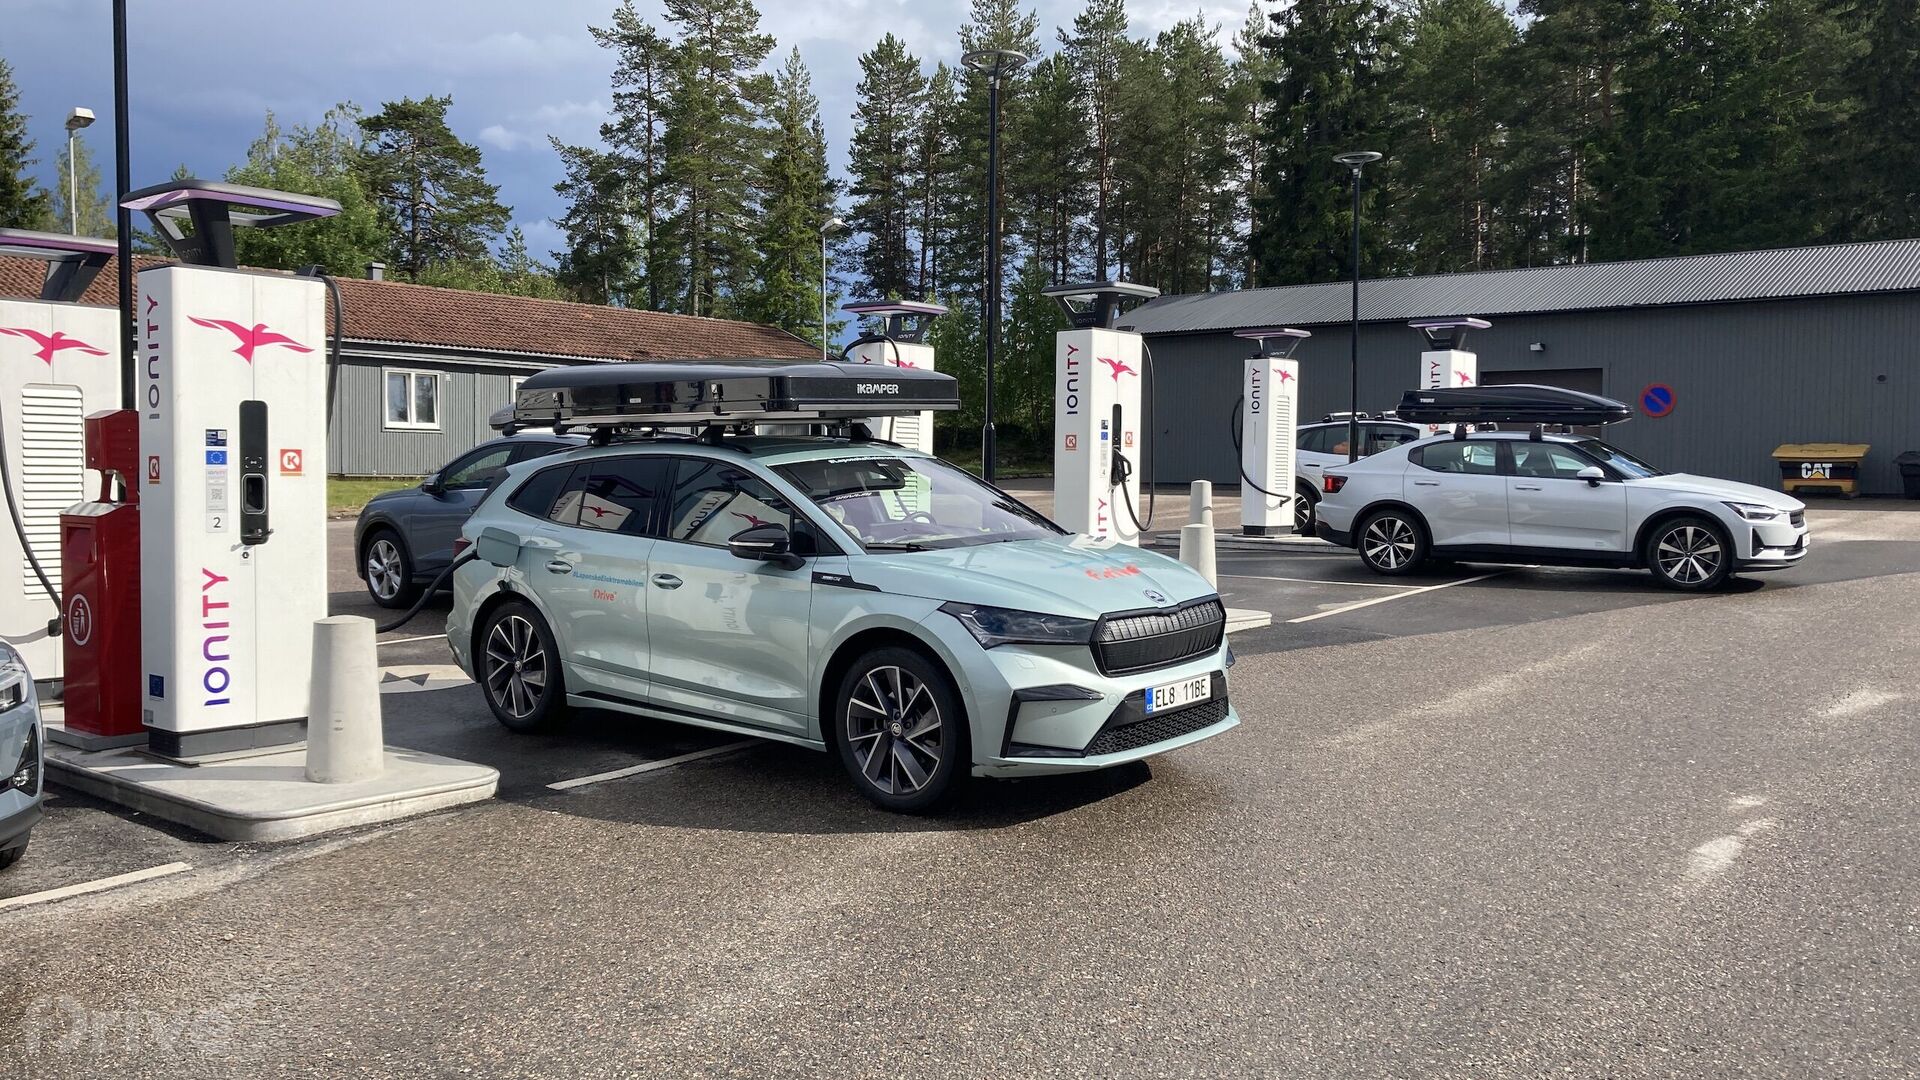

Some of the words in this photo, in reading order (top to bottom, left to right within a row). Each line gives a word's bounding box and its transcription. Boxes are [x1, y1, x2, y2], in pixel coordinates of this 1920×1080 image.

[147, 294, 160, 420] IONITY
[1066, 344, 1079, 414] IONITY
[1252, 368, 1260, 414] IONITY
[1801, 463, 1832, 479] CAT
[213, 516, 221, 529] 2
[203, 567, 230, 706] IONITY
[1155, 687, 1175, 708] EL8
[1183, 678, 1206, 700] 11BE
